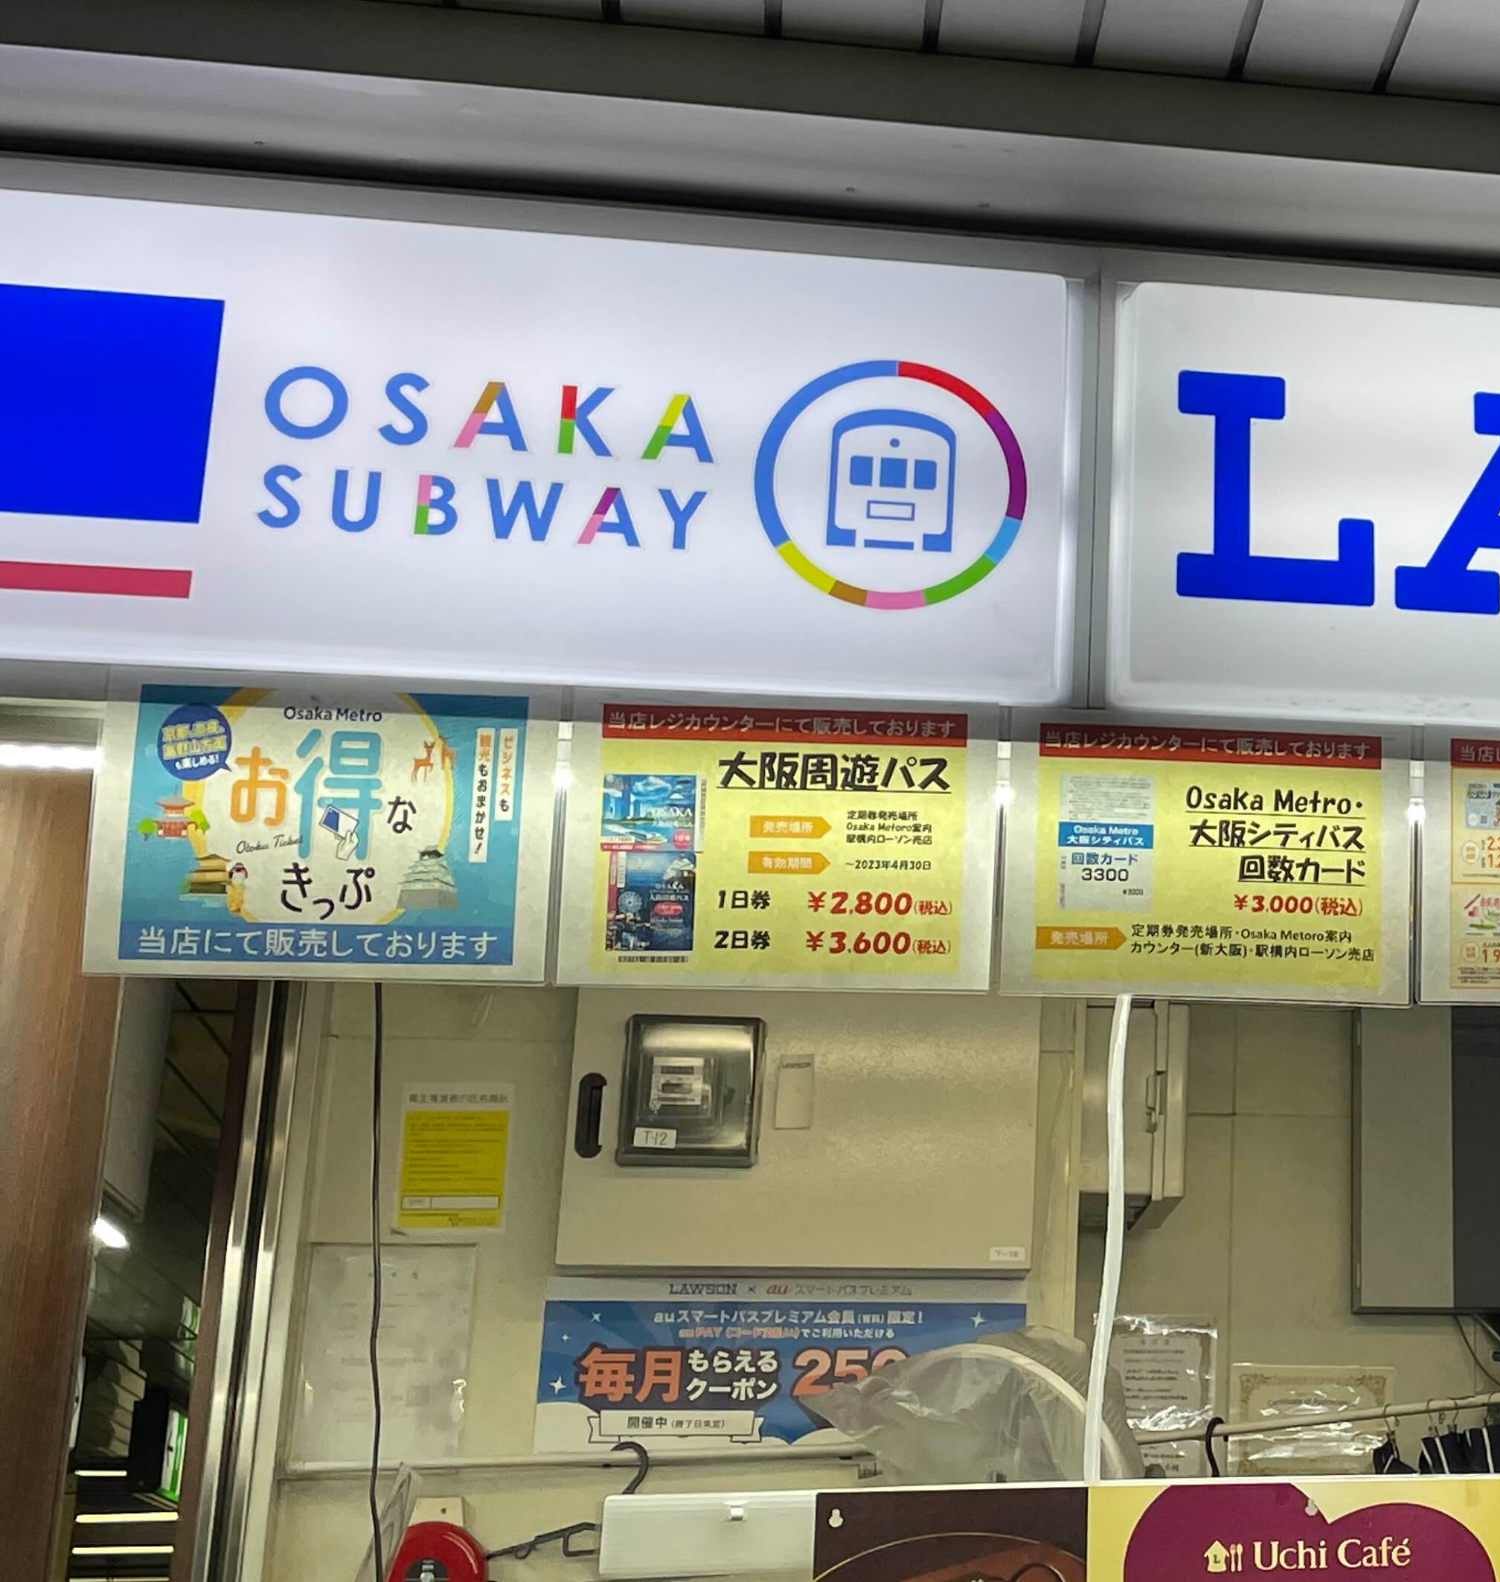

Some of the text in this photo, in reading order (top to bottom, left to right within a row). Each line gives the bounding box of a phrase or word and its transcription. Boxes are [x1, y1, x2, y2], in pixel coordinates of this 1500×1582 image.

[265, 366, 713, 463] OSAKA
[258, 465, 706, 549] SUBWAY
[284, 706, 382, 722] Osaka Metro
[608, 711, 956, 739] 当店レジカウンターにて販売しております
[1045, 731, 1370, 760] 当店レジカウンターにて販売しております
[719, 751, 951, 791] 大阪周遊パス
[1186, 786, 1264, 811] Osaka
[846, 822, 875, 832] Osaka
[1074, 825, 1106, 834] Osaka
[1189, 818, 1366, 851] 大阪シティバス
[1067, 835, 1145, 847] 大阪シティバス
[1071, 851, 1139, 866] 回数カード
[1239, 854, 1366, 883] 回数カード
[1081, 868, 1129, 881] 3300
[281, 862, 375, 920] きっぷ
[718, 890, 771, 910] 1日券
[138, 925, 498, 960] 当店にて販売しております
[714, 930, 771, 950] 2日券
[669, 1283, 737, 1295] LAWSON
[578, 1346, 682, 1403] 毎月
[687, 1349, 778, 1373] もらえる
[685, 1377, 778, 1401] クーポン
[1253, 1540, 1328, 1570] Uchi
[1337, 1536, 1411, 1568] Café
